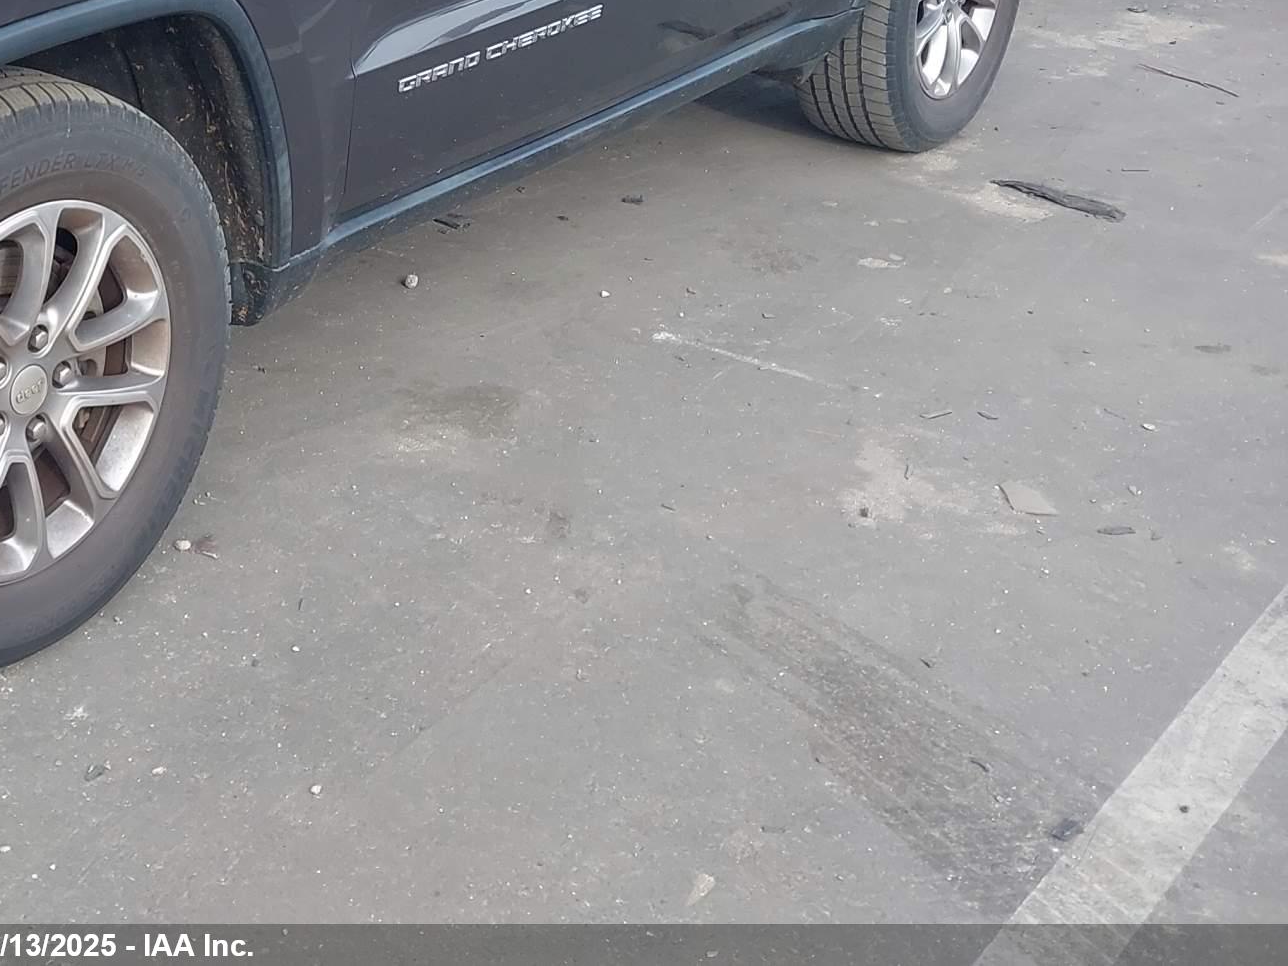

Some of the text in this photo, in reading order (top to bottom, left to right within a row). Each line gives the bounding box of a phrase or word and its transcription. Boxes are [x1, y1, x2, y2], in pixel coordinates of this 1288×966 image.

[397, 3, 604, 94] GRAND CHEROKEE
[83, 152, 122, 171] LTX
